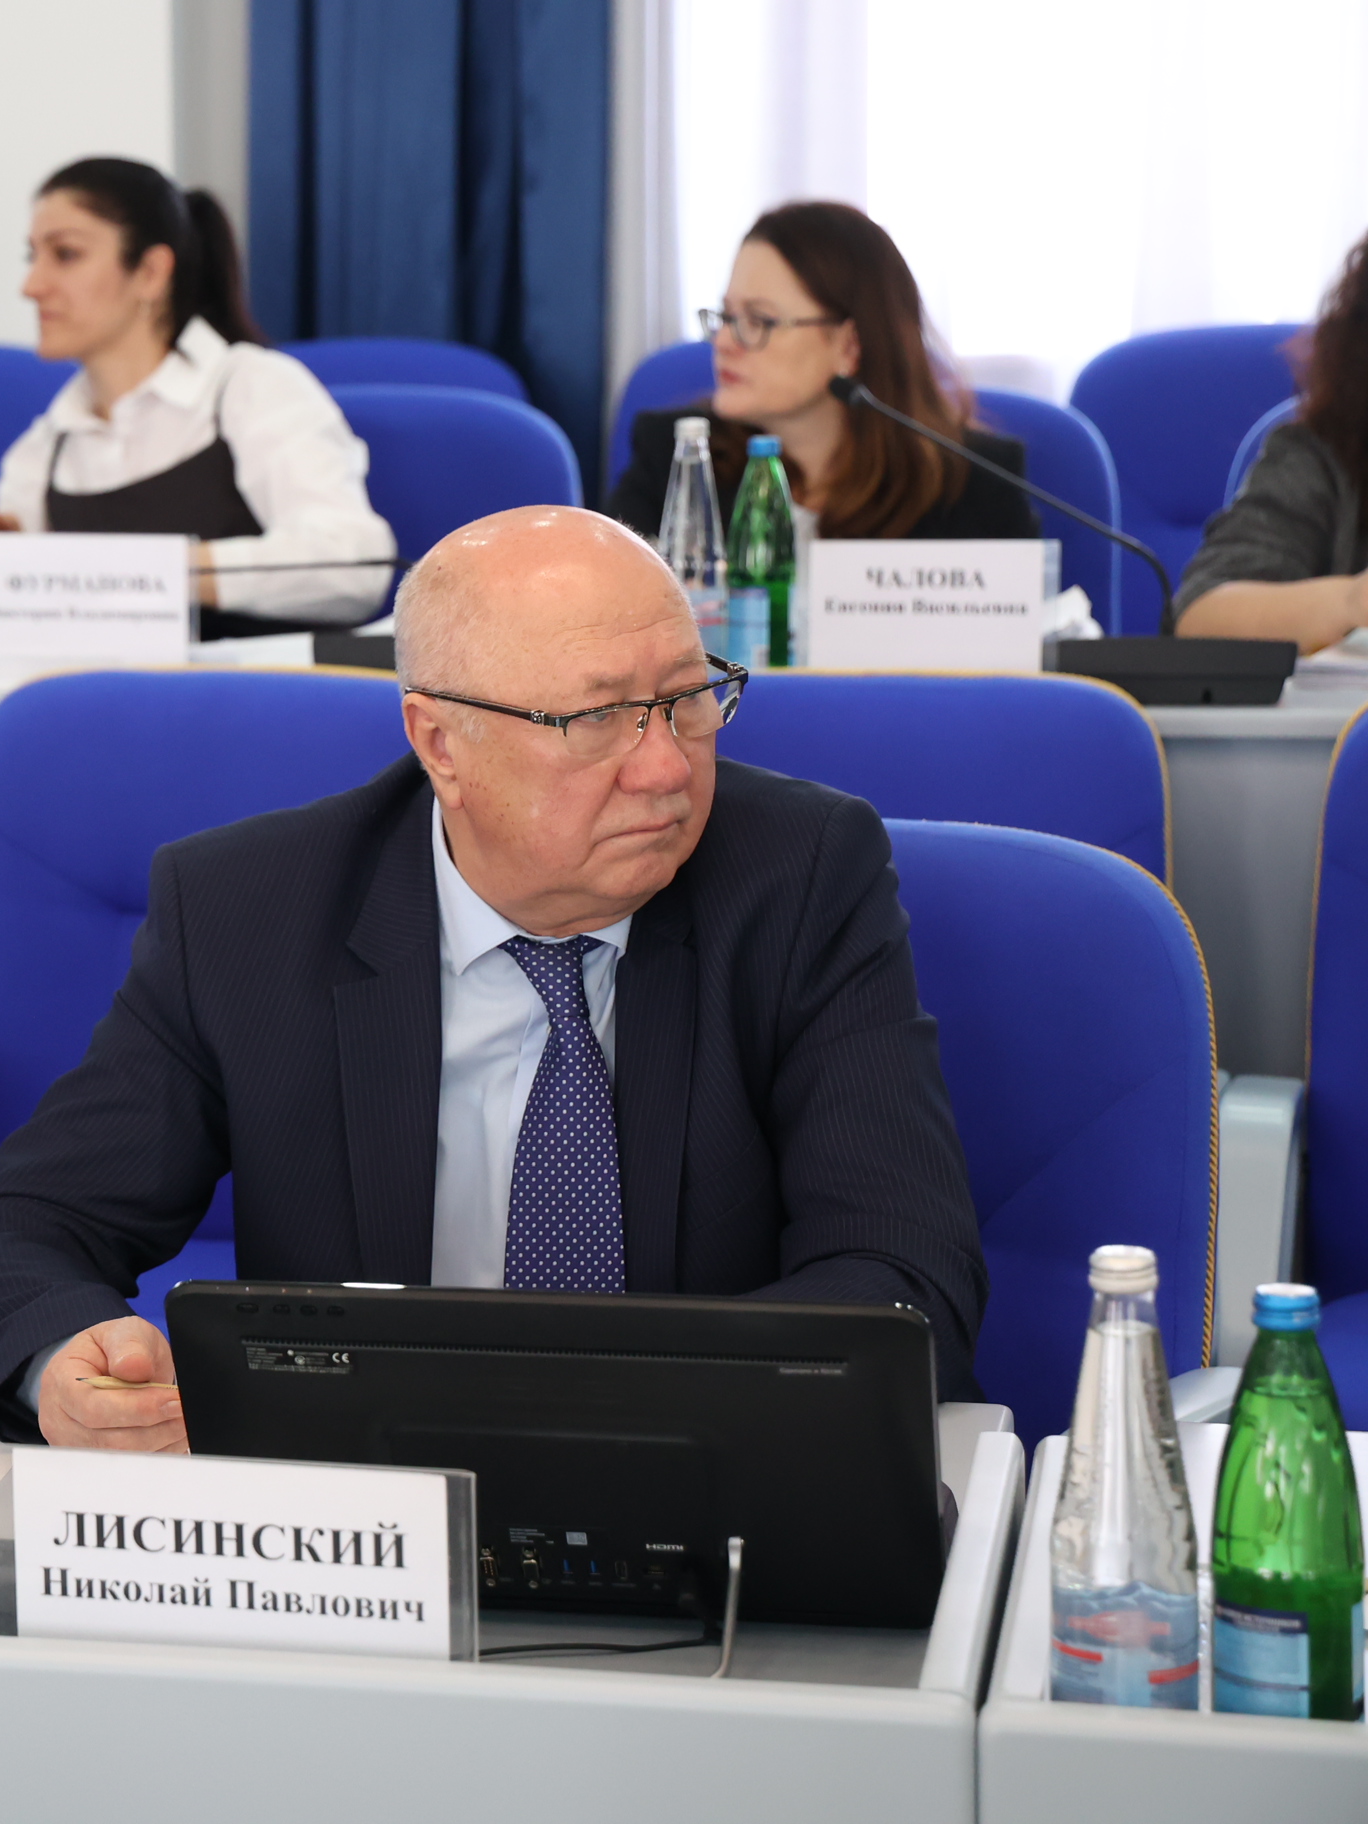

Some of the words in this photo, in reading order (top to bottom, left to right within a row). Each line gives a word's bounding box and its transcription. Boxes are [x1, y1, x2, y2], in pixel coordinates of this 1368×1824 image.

[866, 566, 987, 589] ЧАЛОВА
[52, 1510, 408, 1570] ЛИСИНСКИЙ
[40, 1566, 214, 1609] Николай
[228, 1578, 426, 1623] Павлович
